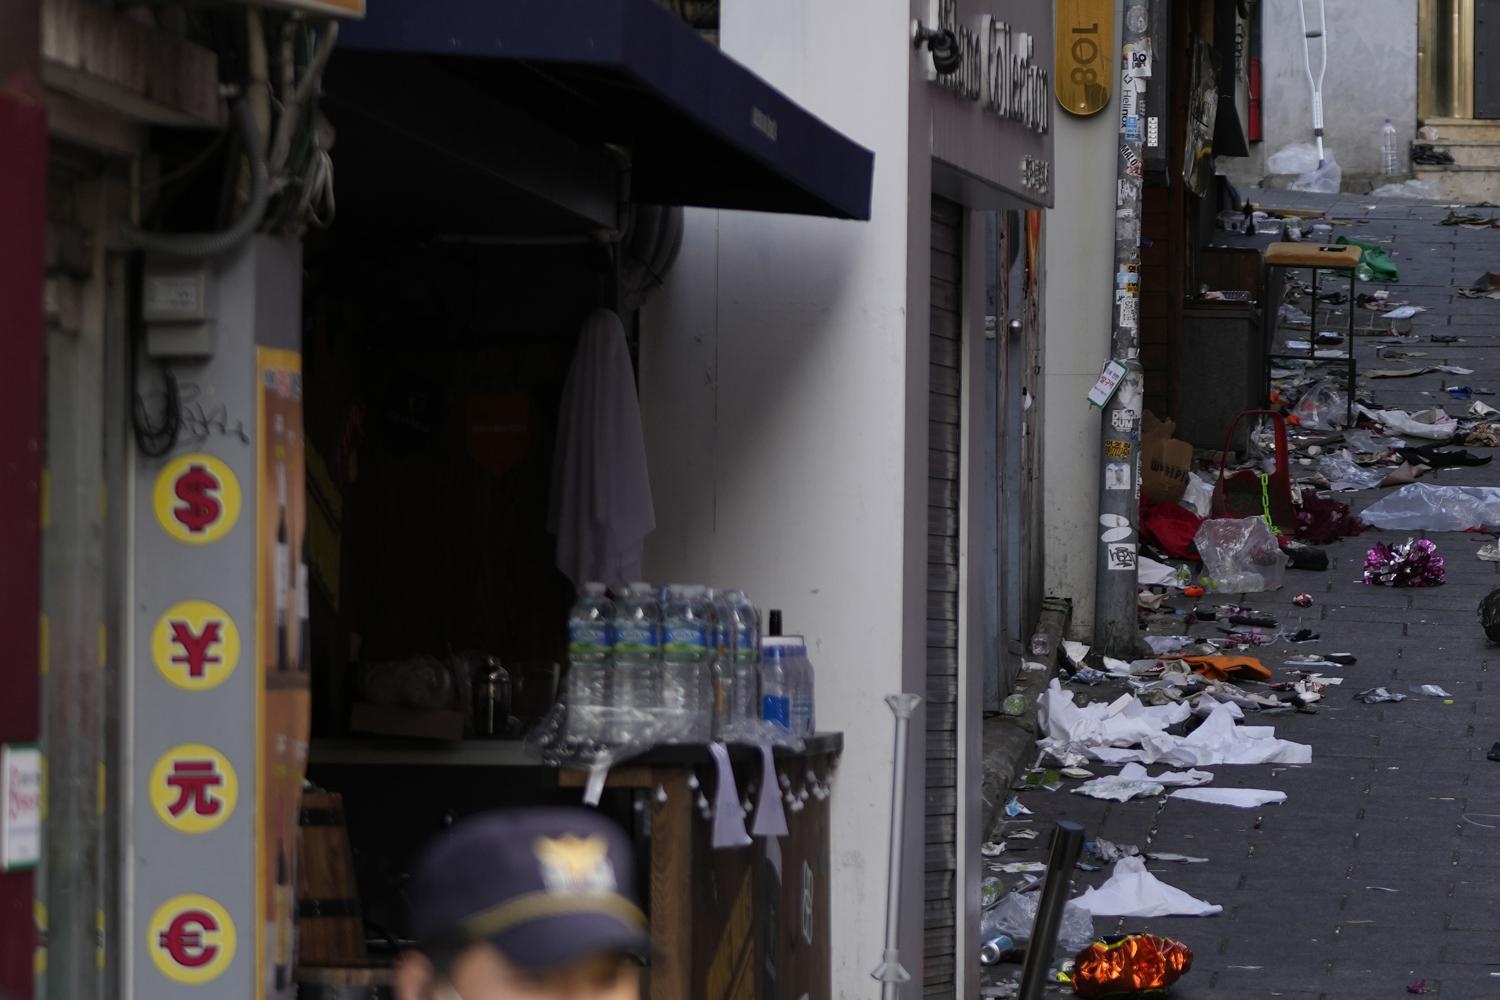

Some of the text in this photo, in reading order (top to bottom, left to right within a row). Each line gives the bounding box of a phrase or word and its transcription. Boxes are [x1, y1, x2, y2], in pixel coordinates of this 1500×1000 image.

[1071, 23, 1099, 86] 108
[1121, 89, 1132, 129] Helinox
[167, 761, 221, 817] 元
